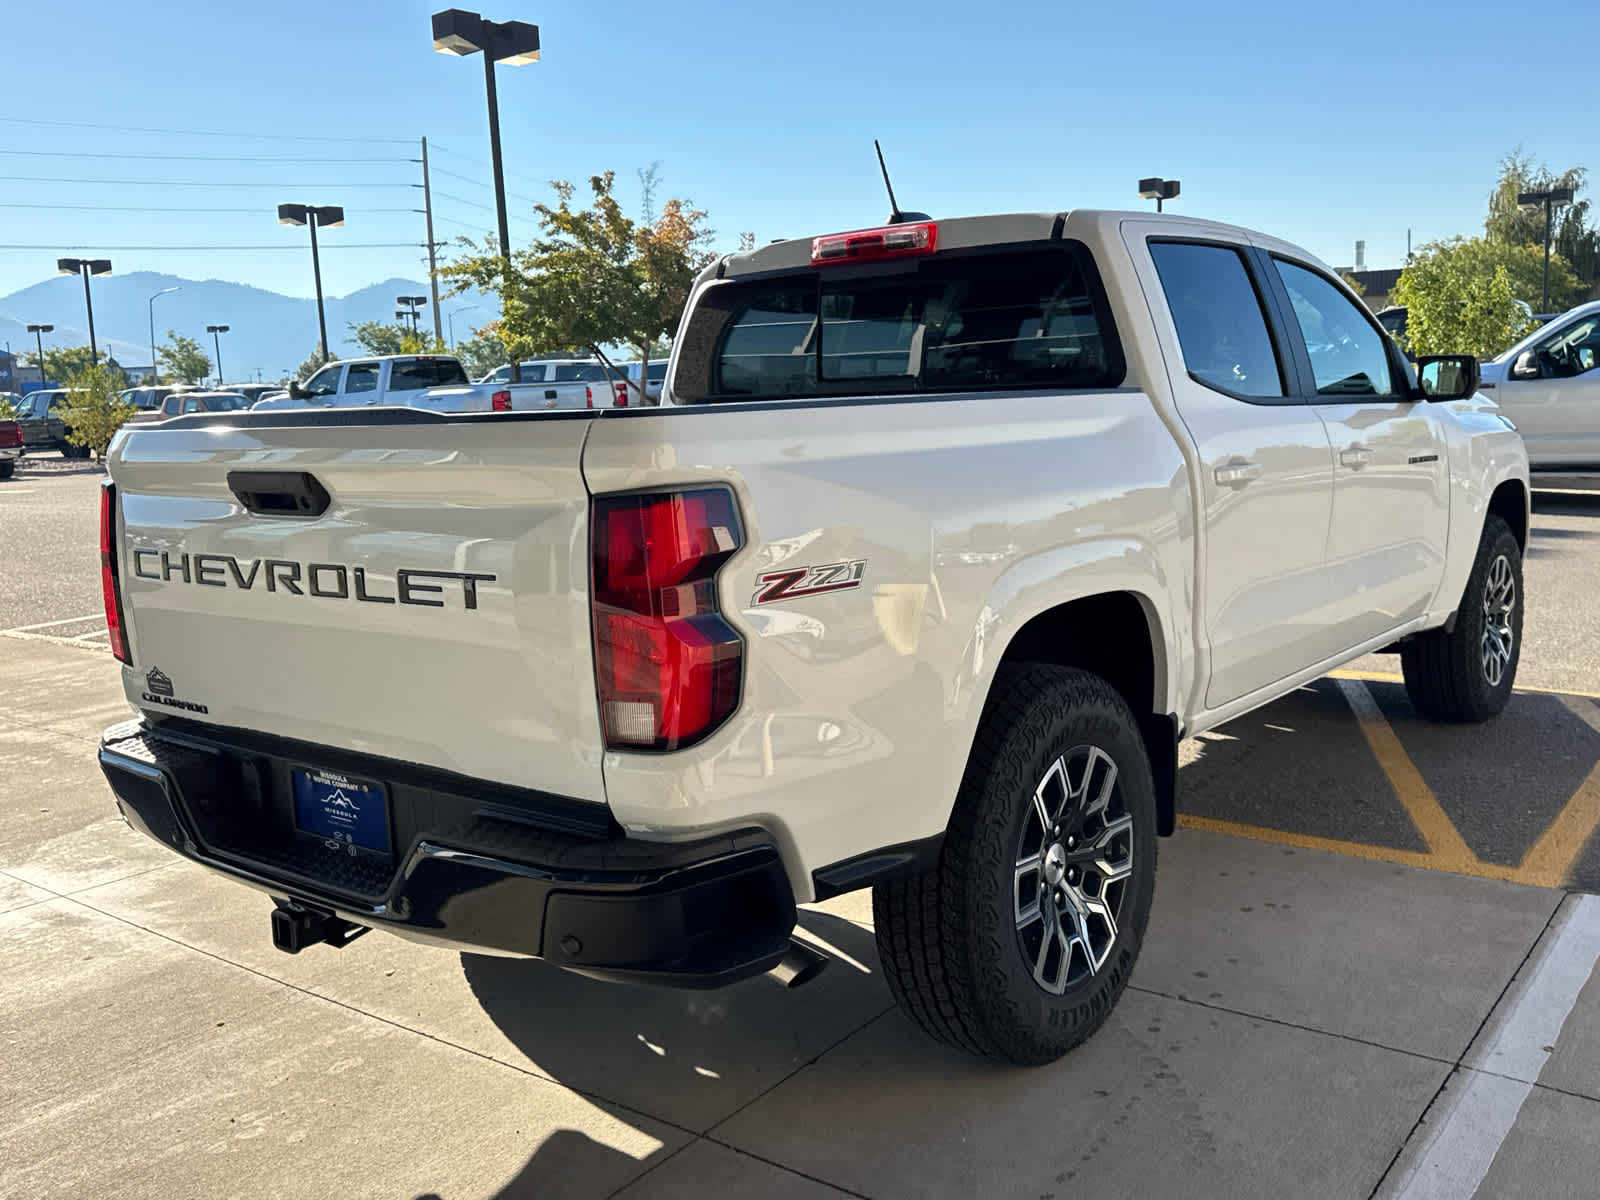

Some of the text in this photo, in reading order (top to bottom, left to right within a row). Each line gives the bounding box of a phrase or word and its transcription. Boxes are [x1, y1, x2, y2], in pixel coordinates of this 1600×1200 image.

[133, 548, 497, 610] CHEVROLET
[750, 559, 867, 607] Z71
[142, 692, 208, 715] COLORADO
[332, 780, 359, 791] COMPANY
[325, 807, 358, 818] MISSOULA
